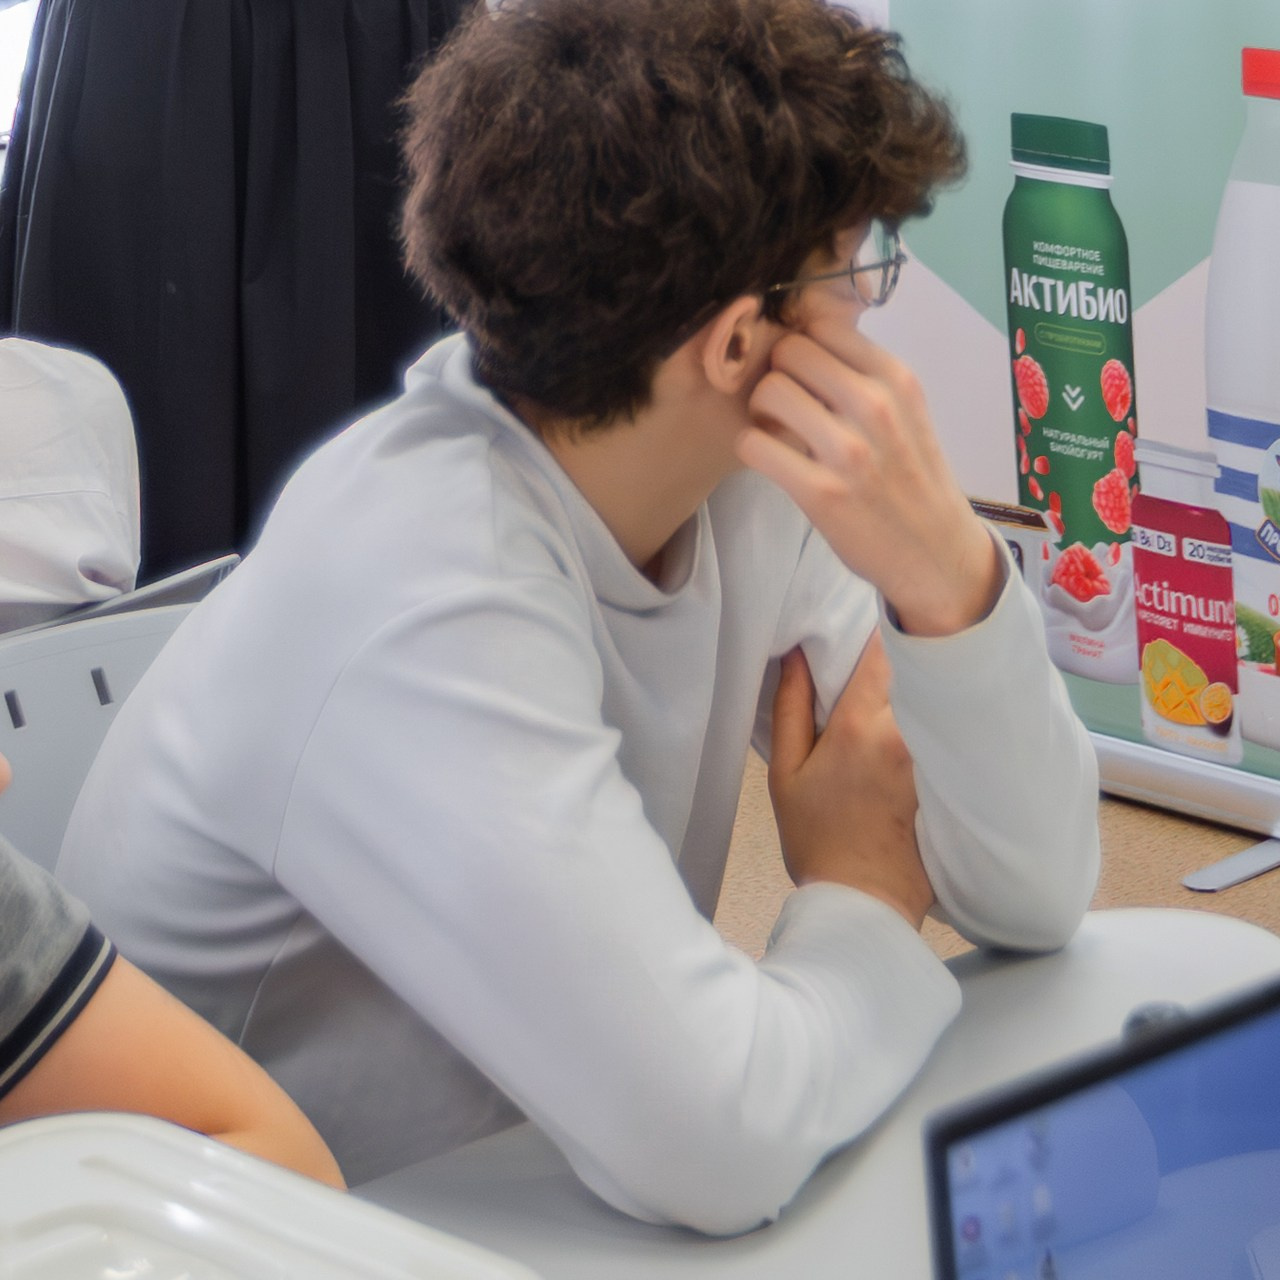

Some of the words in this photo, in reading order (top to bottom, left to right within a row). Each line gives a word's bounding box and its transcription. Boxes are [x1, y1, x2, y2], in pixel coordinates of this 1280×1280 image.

[1033, 240, 1102, 261] КОМФОРТНОЕ
[1010, 267, 1128, 324] АКТИБИО
[1042, 426, 1110, 449] НАТУРАЛЬНЫЙ
[1188, 542, 1206, 560] 20
